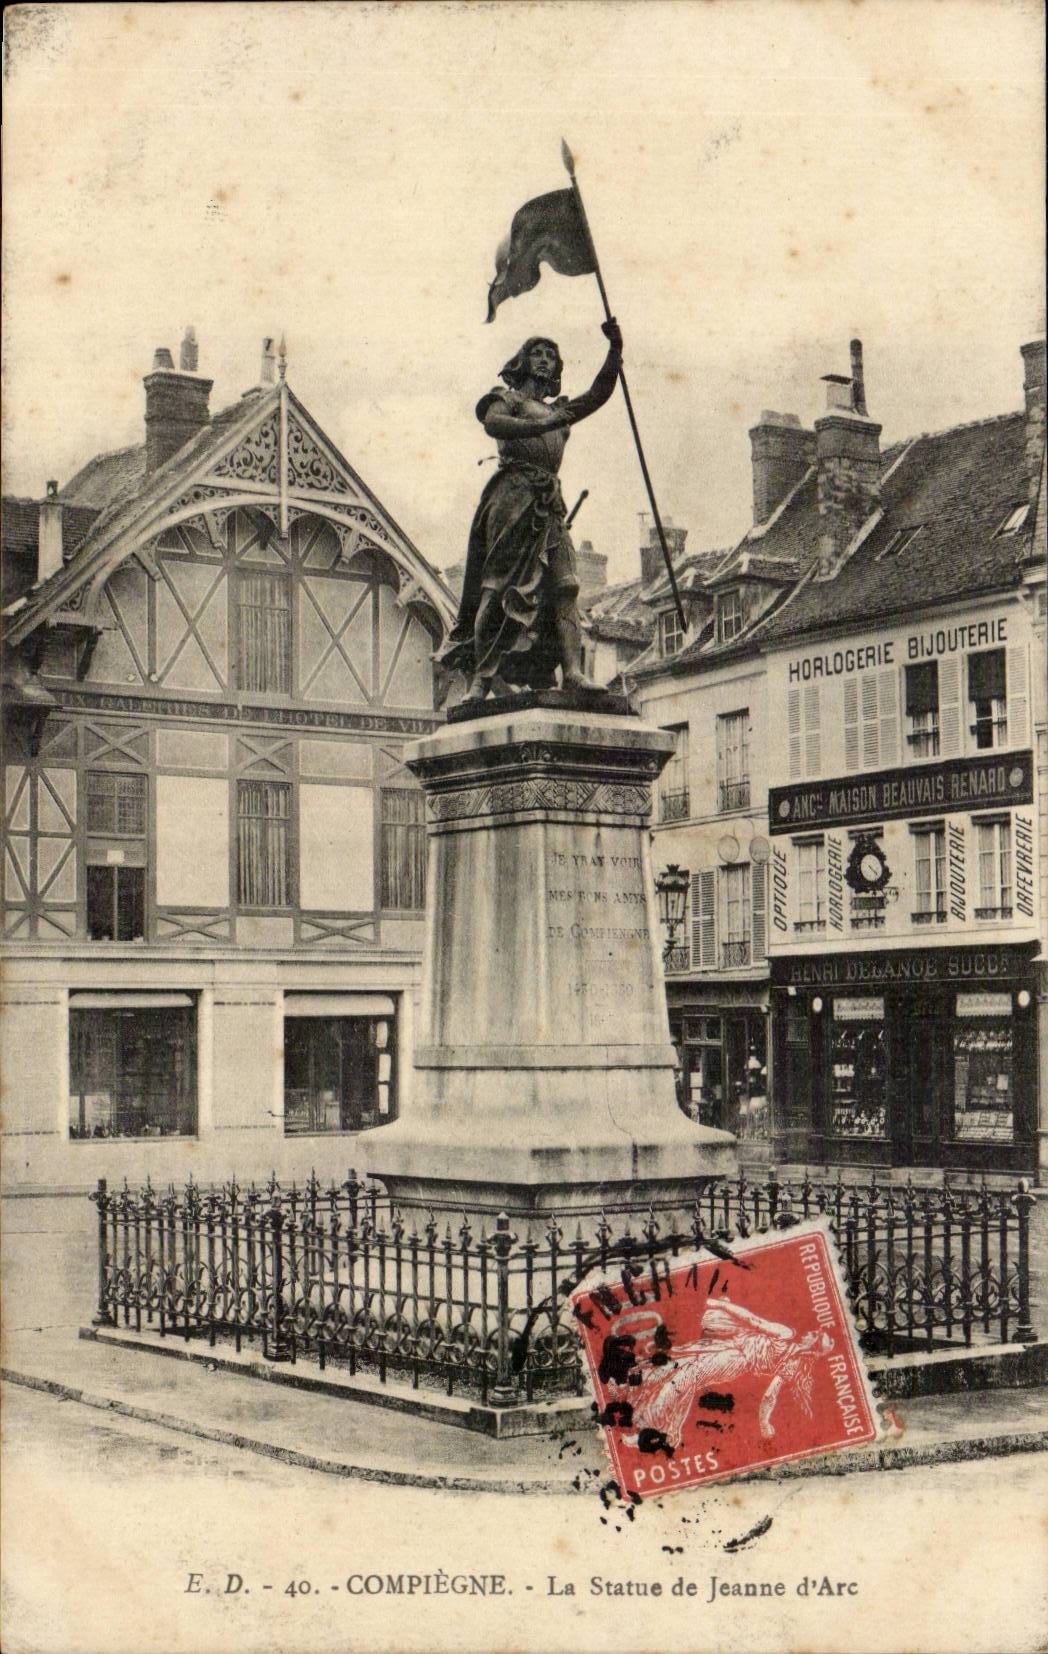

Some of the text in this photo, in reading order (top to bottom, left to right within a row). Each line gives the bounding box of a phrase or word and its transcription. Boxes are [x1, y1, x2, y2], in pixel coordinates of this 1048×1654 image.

[789, 618, 1007, 683] HORLOGERIE BIJOUTERIE
[224, 706, 248, 721] DE
[360, 716, 386, 731] DE
[400, 720, 438, 735] VILL
[828, 783, 877, 816] MAISON
[883, 775, 945, 808] BEAUVAIS
[951, 767, 1006, 797] RENARD
[773, 844, 787, 932] OPTIQUE
[828, 835, 843, 933] HORLOGERIE
[950, 820, 967, 922] BIJOUTERIE
[1015, 812, 1034, 917] ORFEVRERIE
[790, 962, 838, 982] HENRI
[799, 1243, 864, 1436] REPUBLIQUE FRANÇAISE
[633, 1451, 719, 1488] POSTES
